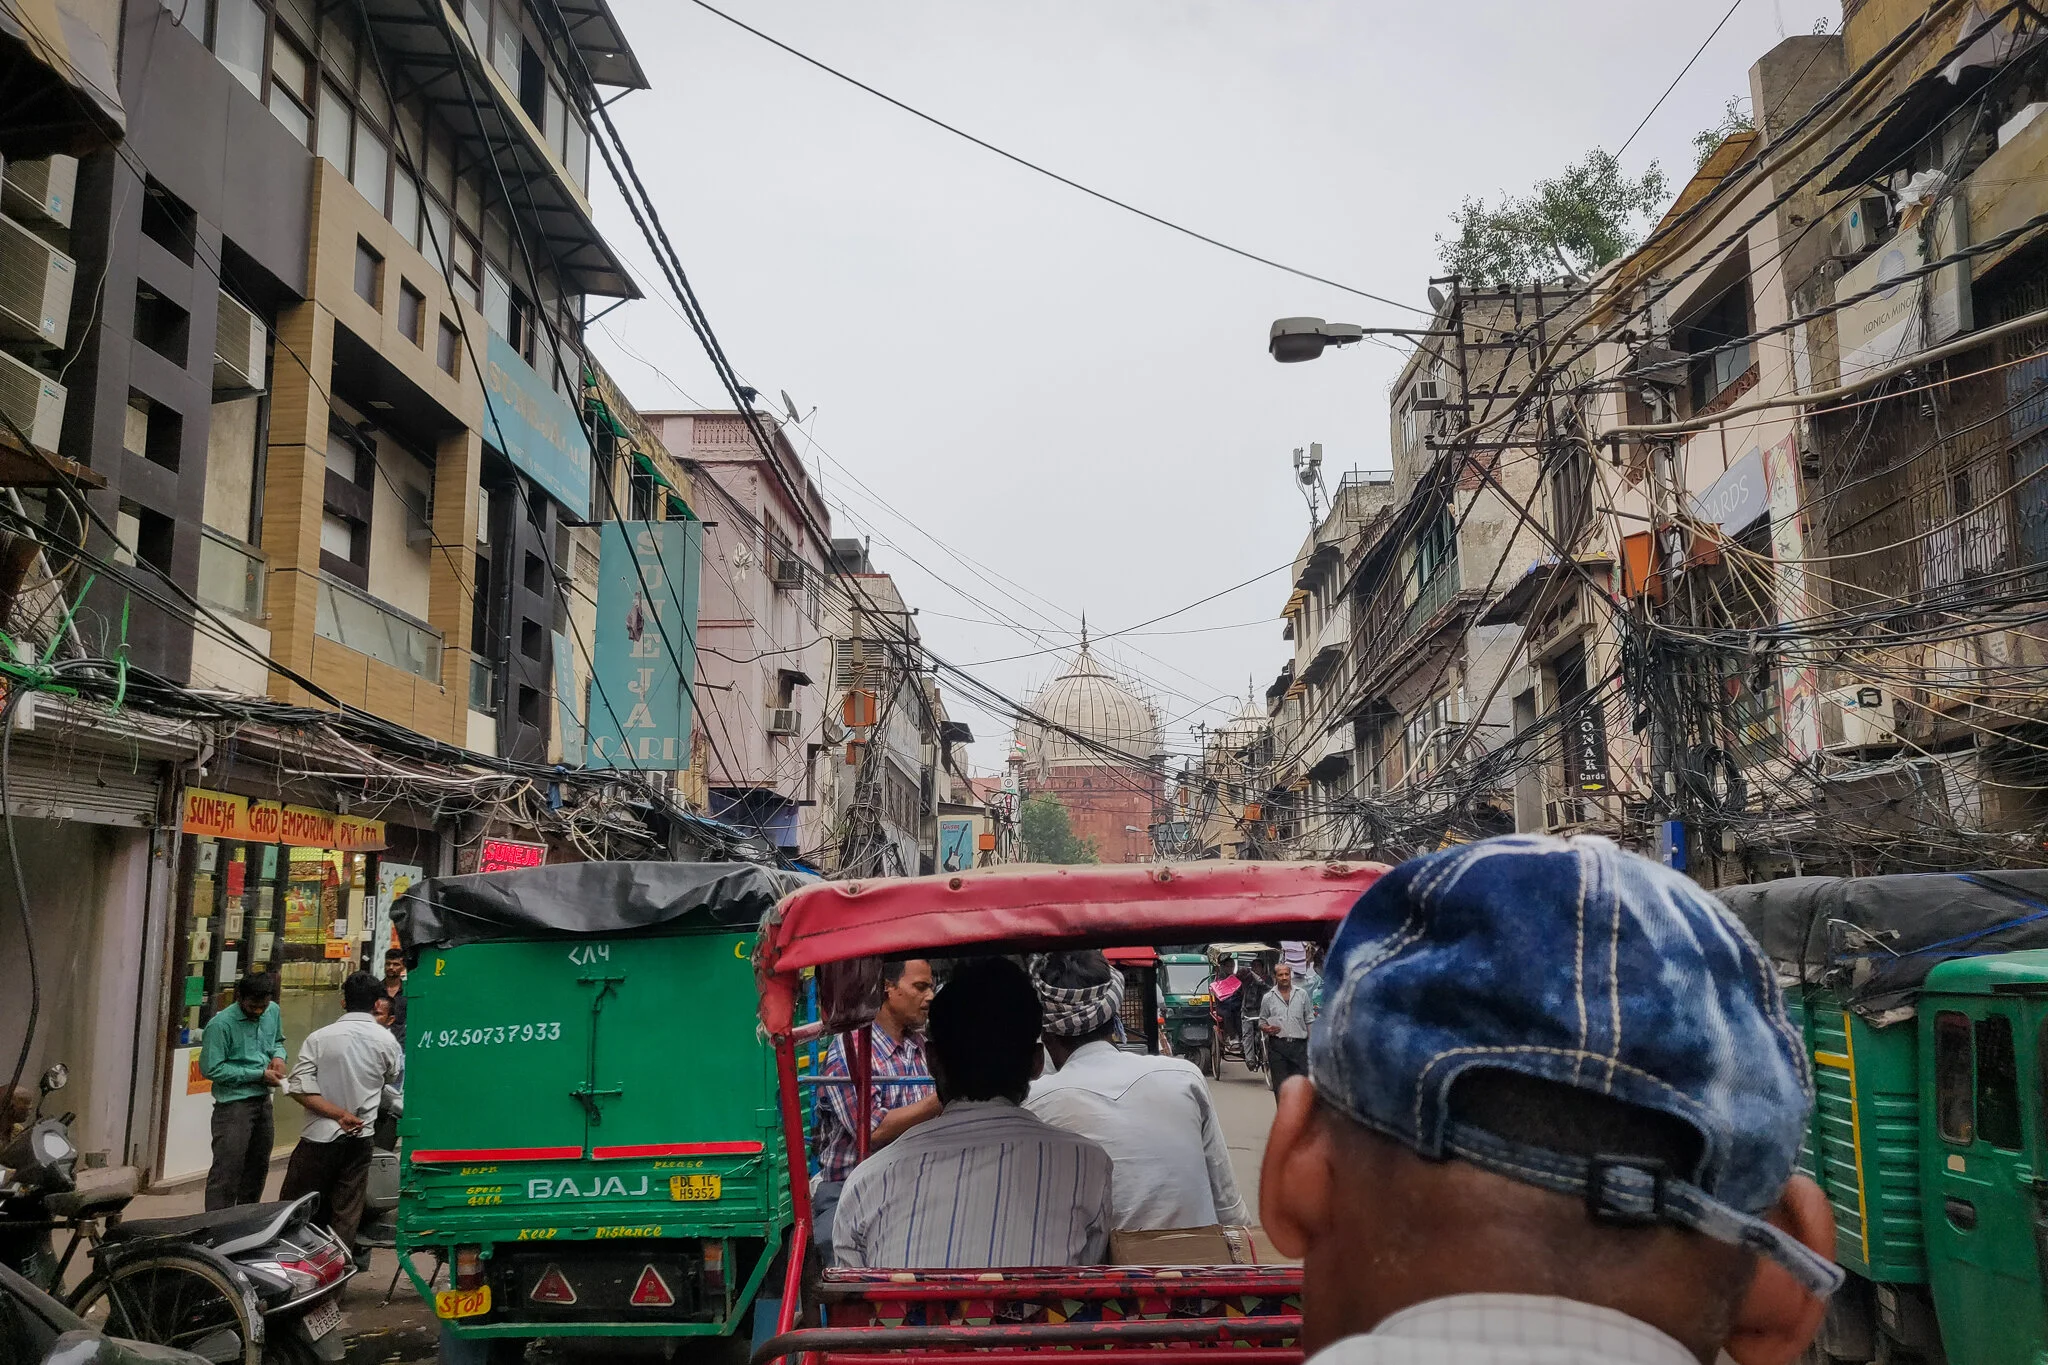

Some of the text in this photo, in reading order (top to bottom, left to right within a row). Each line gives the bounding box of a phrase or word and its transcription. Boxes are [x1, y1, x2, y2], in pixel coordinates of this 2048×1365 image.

[1863, 294, 1916, 335] KONICA MINO
[623, 530, 666, 728] SUNEJA
[592, 735, 686, 761] CARD
[1580, 772, 1606, 781] Cards
[190, 796, 236, 833] SUNEJA
[249, 806, 279, 836] CARD
[281, 810, 334, 842] EMPORIUM
[486, 844, 538, 867] SUNEJA
[437, 1022, 561, 1048] 9250737933
[528, 1175, 649, 1199] BAJAJ
[680, 1176, 694, 1188] DL
[680, 1187, 715, 1199] H9352
[438, 1291, 485, 1315] STOP
